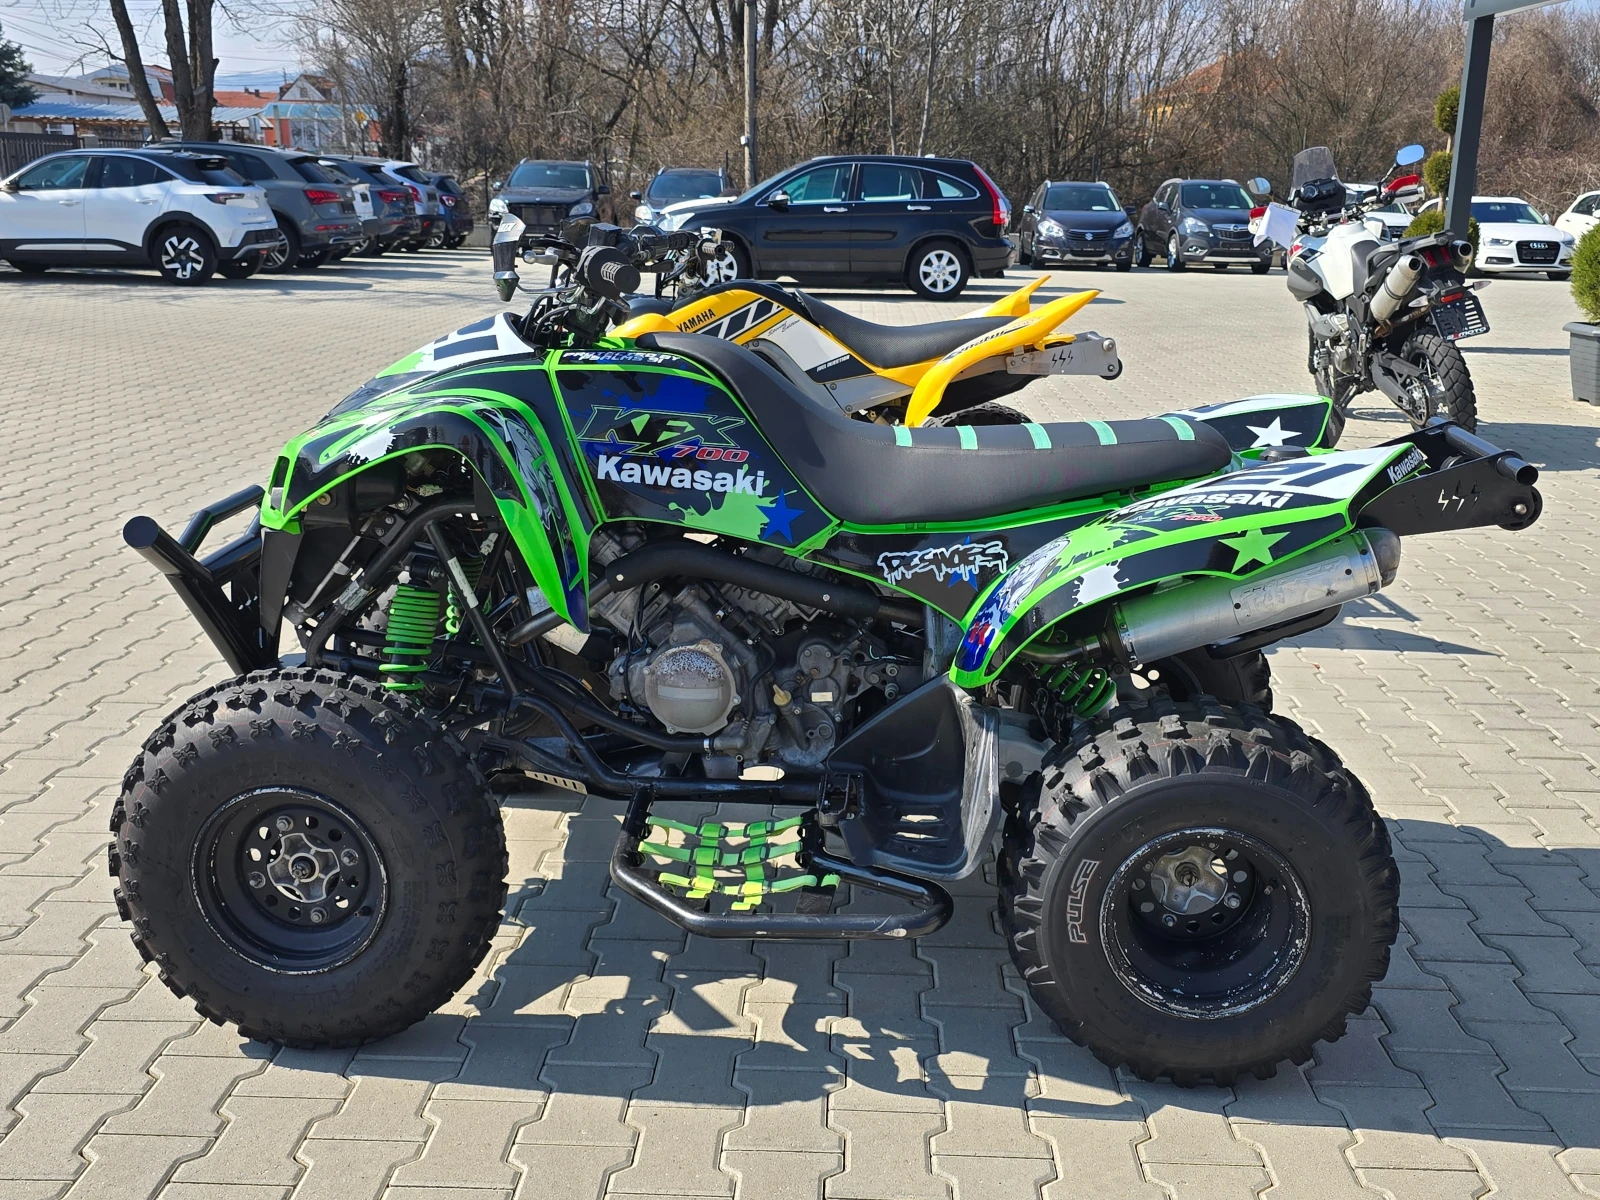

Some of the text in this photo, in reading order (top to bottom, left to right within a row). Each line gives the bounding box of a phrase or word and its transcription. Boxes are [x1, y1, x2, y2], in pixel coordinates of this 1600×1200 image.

[676, 308, 716, 333] YAMAHA
[577, 404, 746, 457] KFX
[672, 444, 750, 462] 700
[597, 454, 765, 496] Kawasaki
[1107, 491, 1294, 519] Kawasaki
[1066, 858, 1101, 944] PULSE
